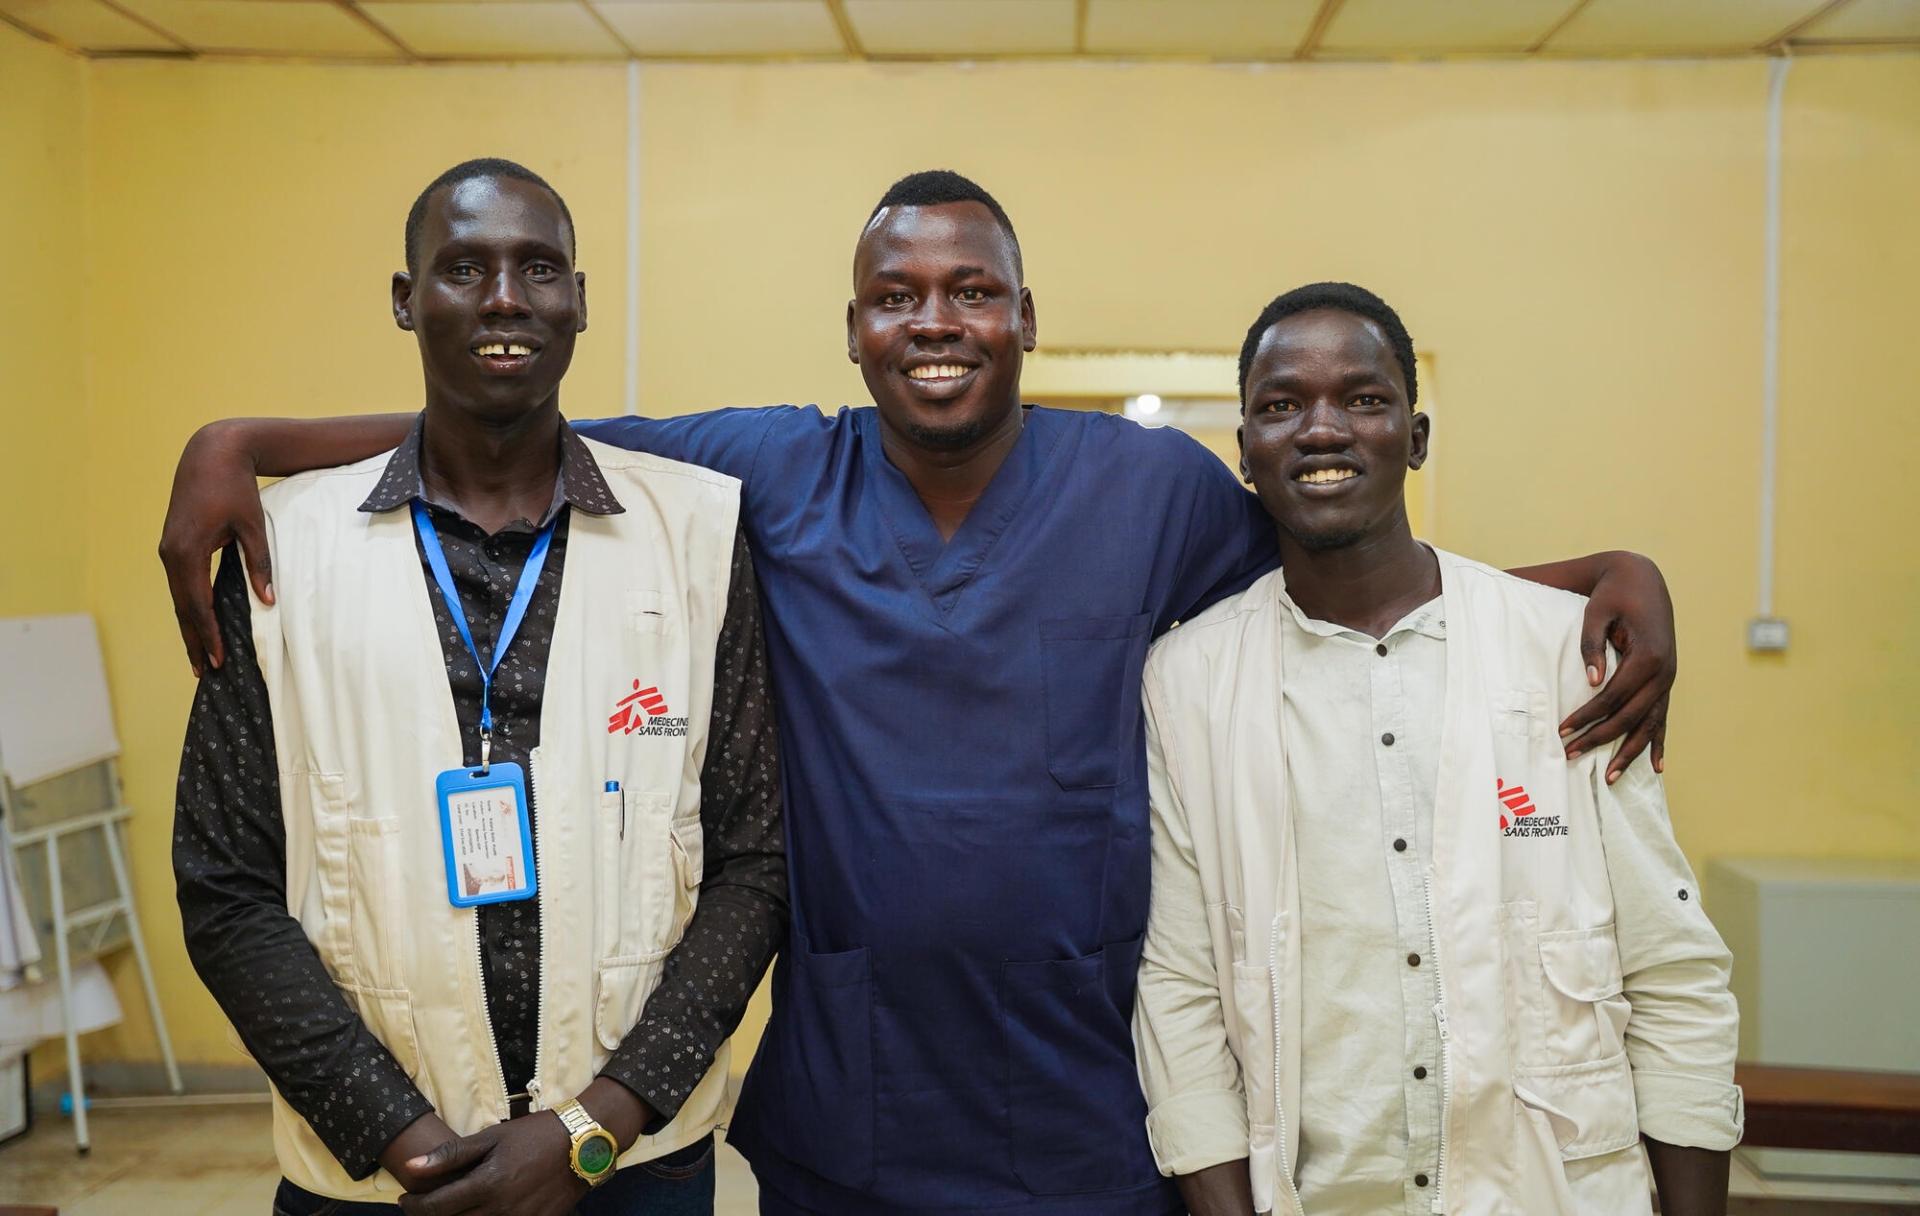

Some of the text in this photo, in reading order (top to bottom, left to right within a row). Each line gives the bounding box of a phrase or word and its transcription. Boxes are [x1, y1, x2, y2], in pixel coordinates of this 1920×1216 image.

[638, 726, 663, 736] SANS
[1514, 815, 1560, 827] MEDECINS
[1504, 827, 1530, 838] SANS
